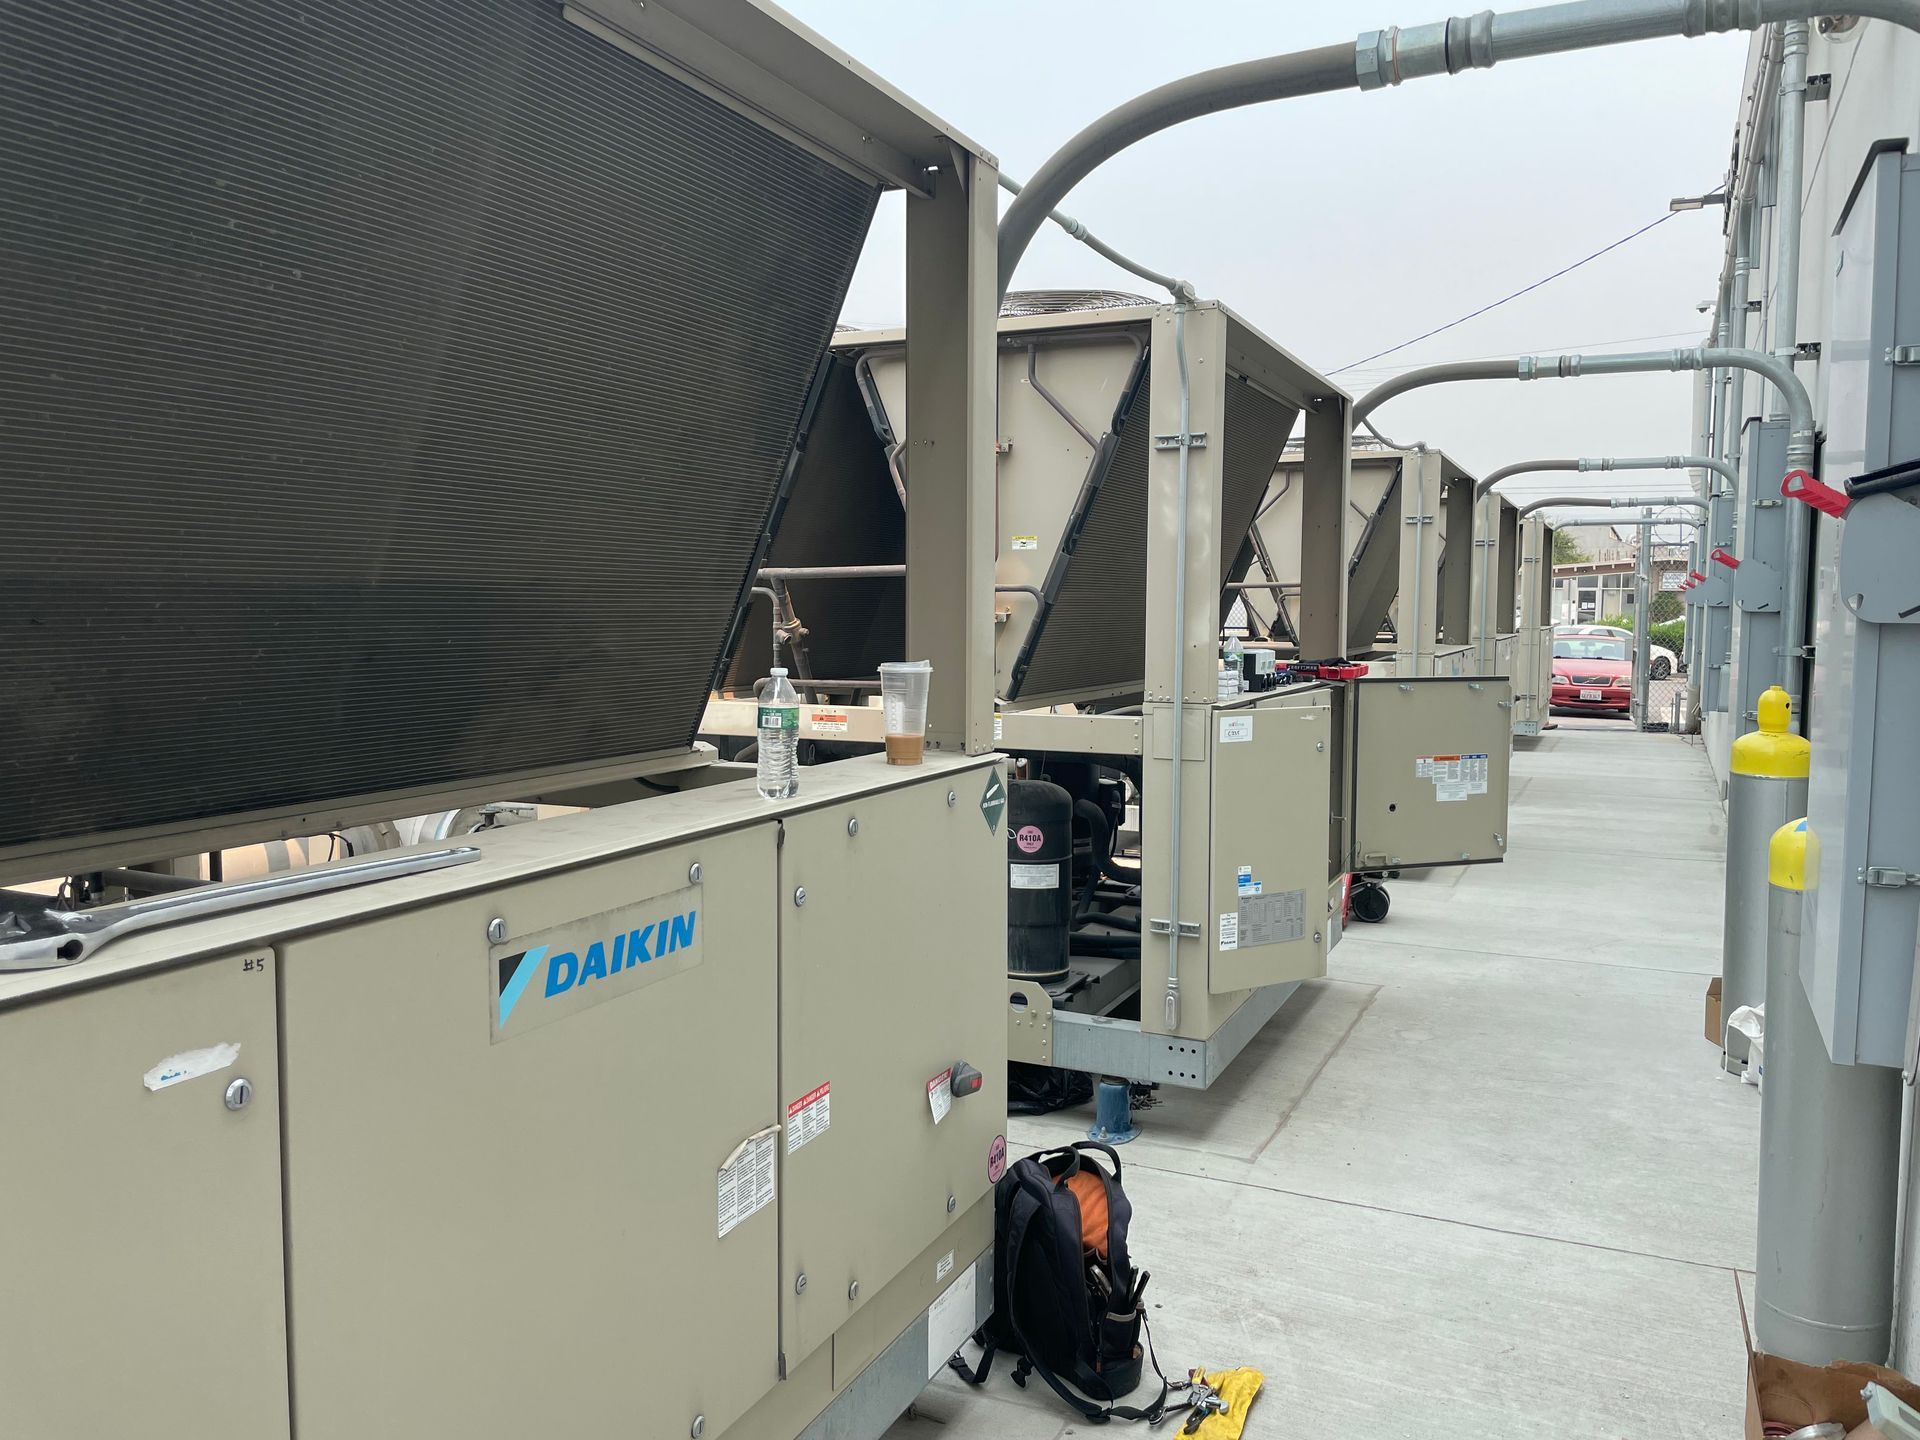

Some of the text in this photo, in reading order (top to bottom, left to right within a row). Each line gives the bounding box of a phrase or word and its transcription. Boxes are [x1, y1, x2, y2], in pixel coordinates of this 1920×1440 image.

[1019, 834, 1042, 842] R410A
[545, 911, 696, 998] DAIKIN
[243, 958, 265, 971] #5
[990, 1147, 1005, 1168] R410A
